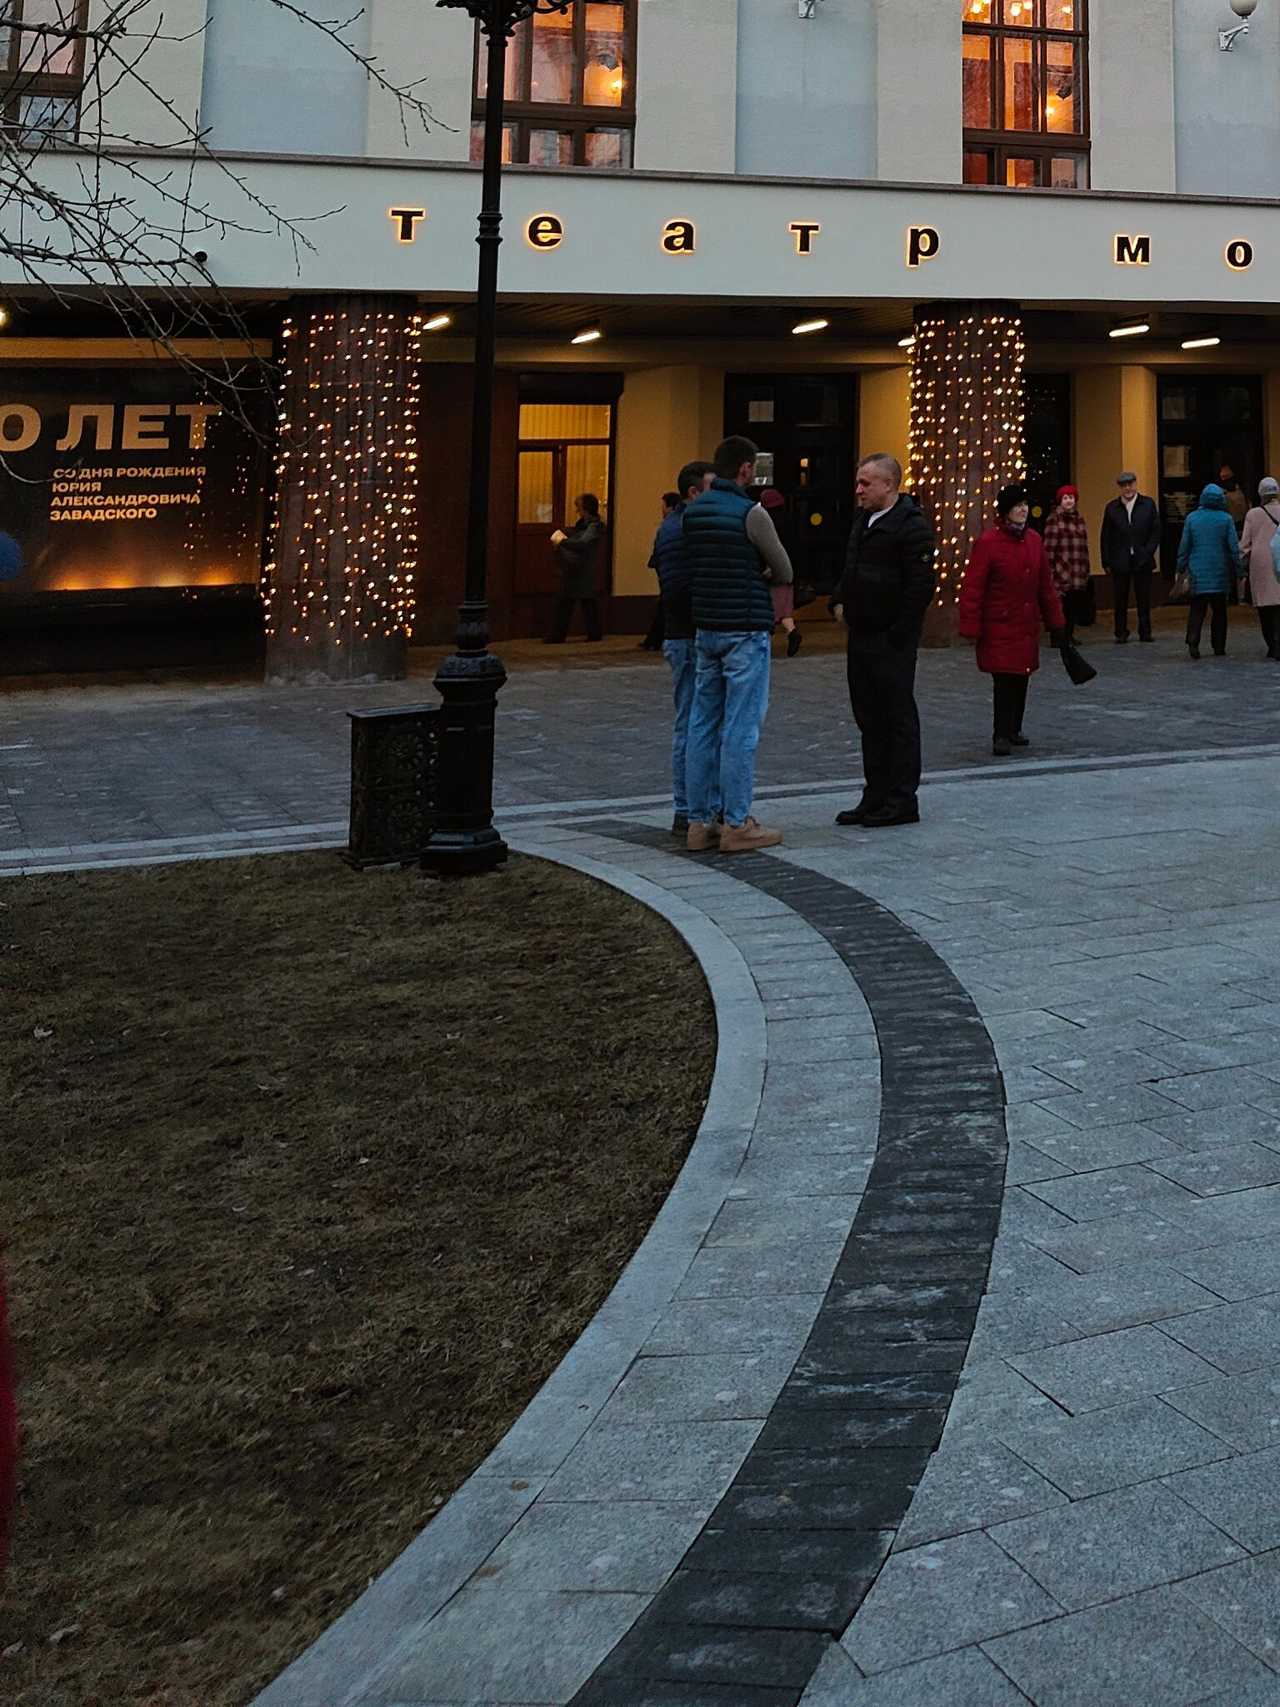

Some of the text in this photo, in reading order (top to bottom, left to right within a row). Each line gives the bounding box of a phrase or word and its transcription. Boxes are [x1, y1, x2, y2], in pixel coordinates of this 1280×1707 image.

[55, 403, 223, 451] ЛЕТ
[78, 467, 113, 479] ДНЯ
[116, 466, 207, 478] РОЖДЕНИЯ
[52, 481, 102, 493] ЮРИЯ
[50, 493, 201, 507] АЛЕКСАНДРОВИЧА
[50, 507, 158, 521] ЗАВАДСКОГО
